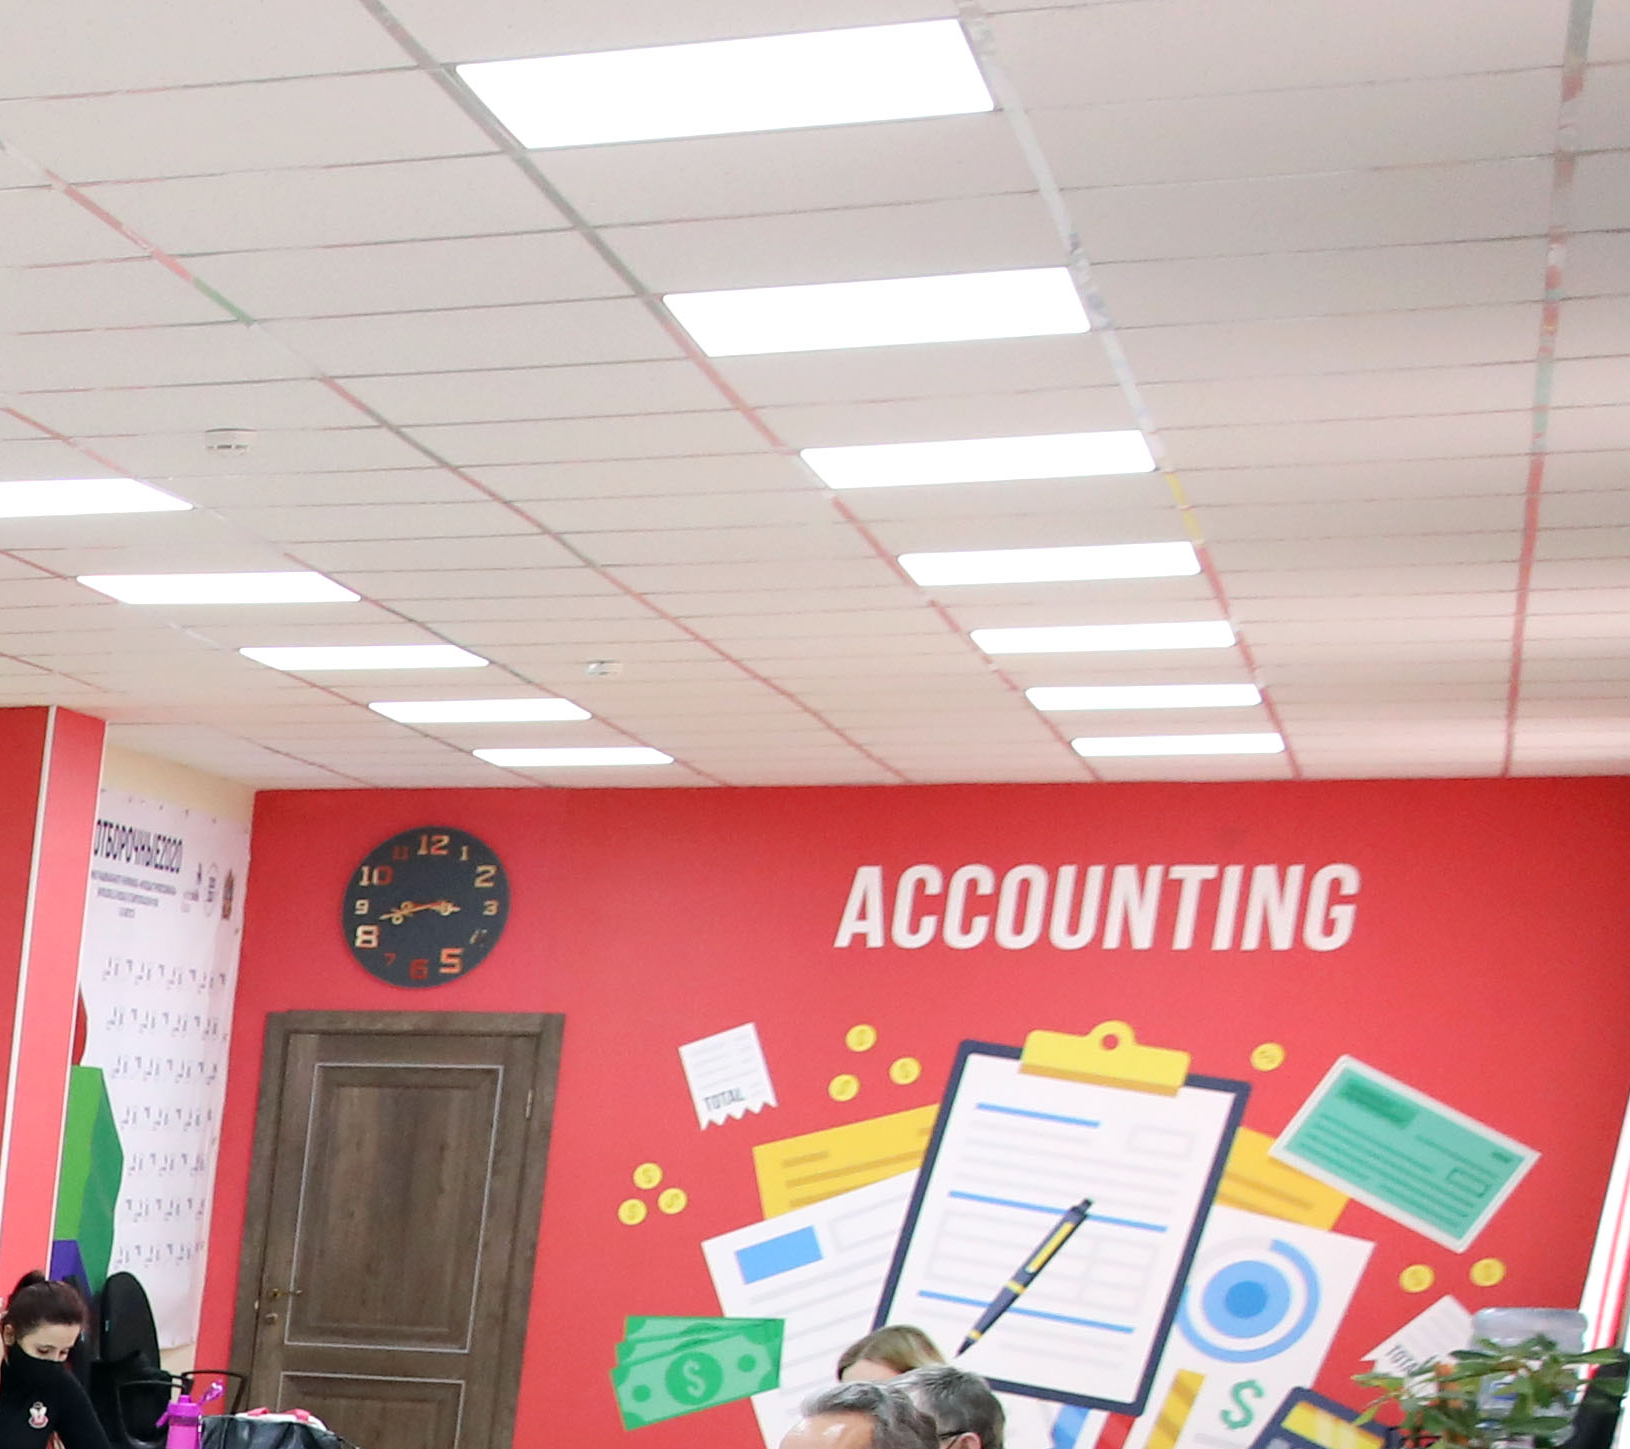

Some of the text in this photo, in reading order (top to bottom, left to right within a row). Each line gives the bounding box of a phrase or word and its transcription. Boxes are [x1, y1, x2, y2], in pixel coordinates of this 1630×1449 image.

[417, 834, 450, 856] 12
[461, 846, 469, 861] 1
[359, 865, 394, 887] 10
[474, 865, 498, 888] 2
[354, 899, 369, 915] 9
[482, 900, 499, 916] 3
[834, 864, 1360, 951] ACCOUNTING
[355, 925, 380, 948] 8
[383, 953, 397, 967] 7
[410, 959, 429, 980] 6
[439, 948, 464, 974] 5
[703, 1087, 747, 1112] TOTAL
